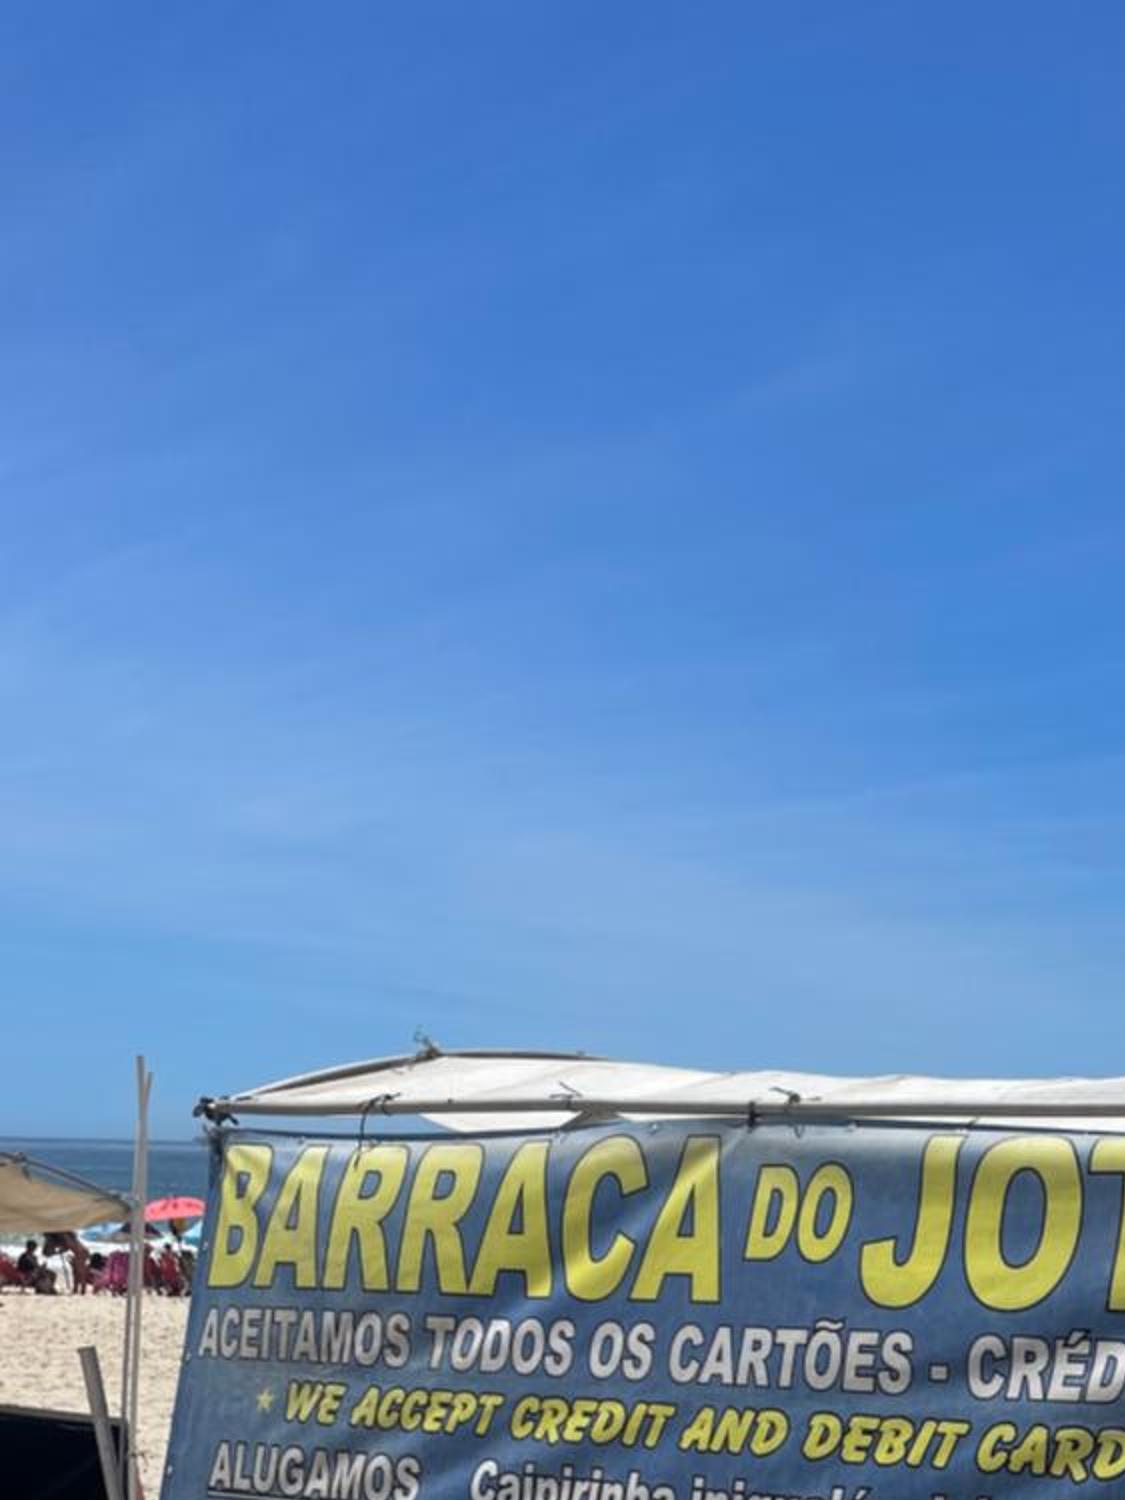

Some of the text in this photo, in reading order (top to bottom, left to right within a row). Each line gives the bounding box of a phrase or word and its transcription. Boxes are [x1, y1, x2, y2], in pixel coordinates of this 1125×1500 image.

[207, 1135, 721, 1303] BARRACA
[743, 1161, 854, 1263] DO
[198, 1308, 411, 1369] ACEITAMOS
[426, 1315, 574, 1379] TODOS
[589, 1319, 657, 1381] OS
[668, 1320, 914, 1394] CARTÕES
[929, 1362, 950, 1382] -
[285, 1382, 345, 1426] WE
[351, 1388, 503, 1436] ACCEPT
[511, 1396, 673, 1447] CREDIT
[680, 1405, 793, 1456] AND
[803, 1414, 971, 1470] DEBIT
